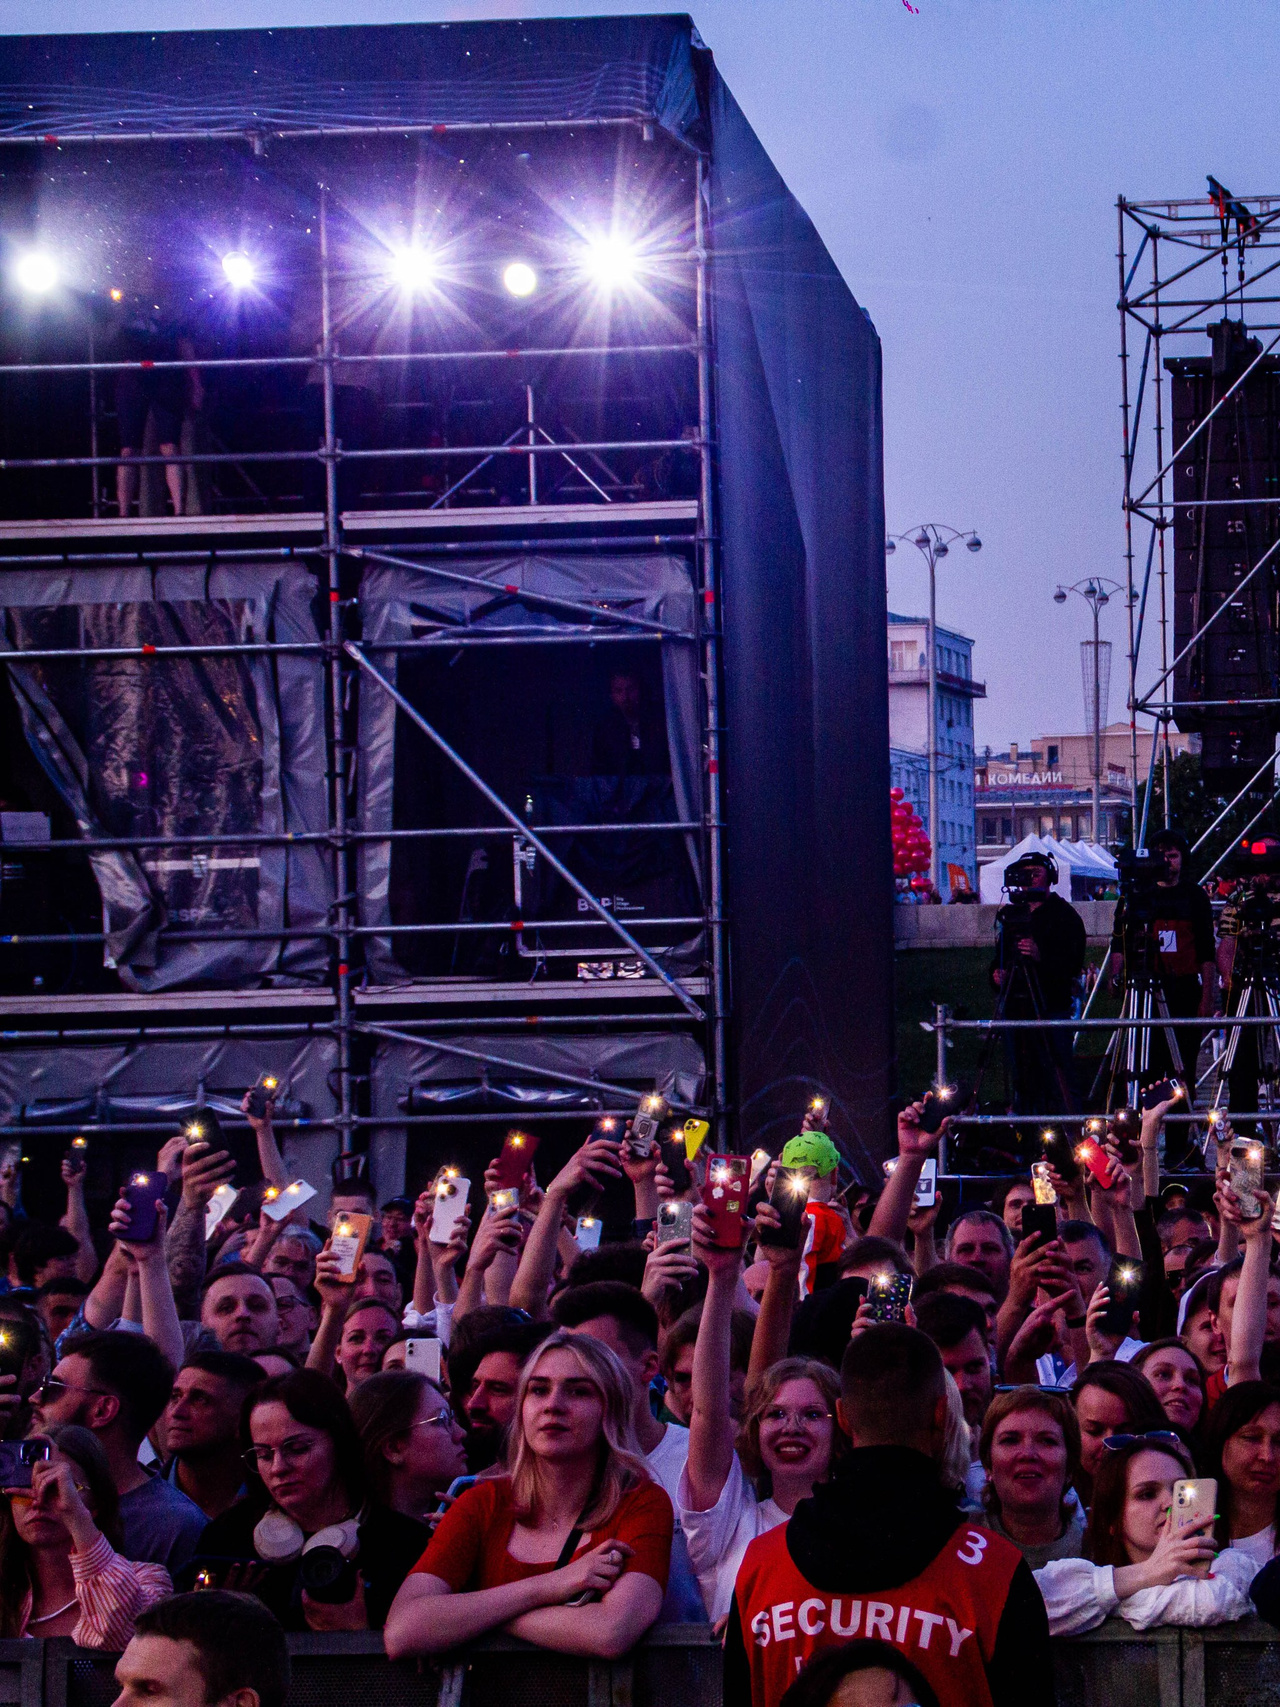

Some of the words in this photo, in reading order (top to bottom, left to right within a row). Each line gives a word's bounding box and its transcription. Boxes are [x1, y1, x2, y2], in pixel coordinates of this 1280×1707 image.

[988, 771, 1062, 786] КОМЕДИИ
[956, 1531, 988, 1565] 3
[751, 1597, 973, 1657] SECURITY
